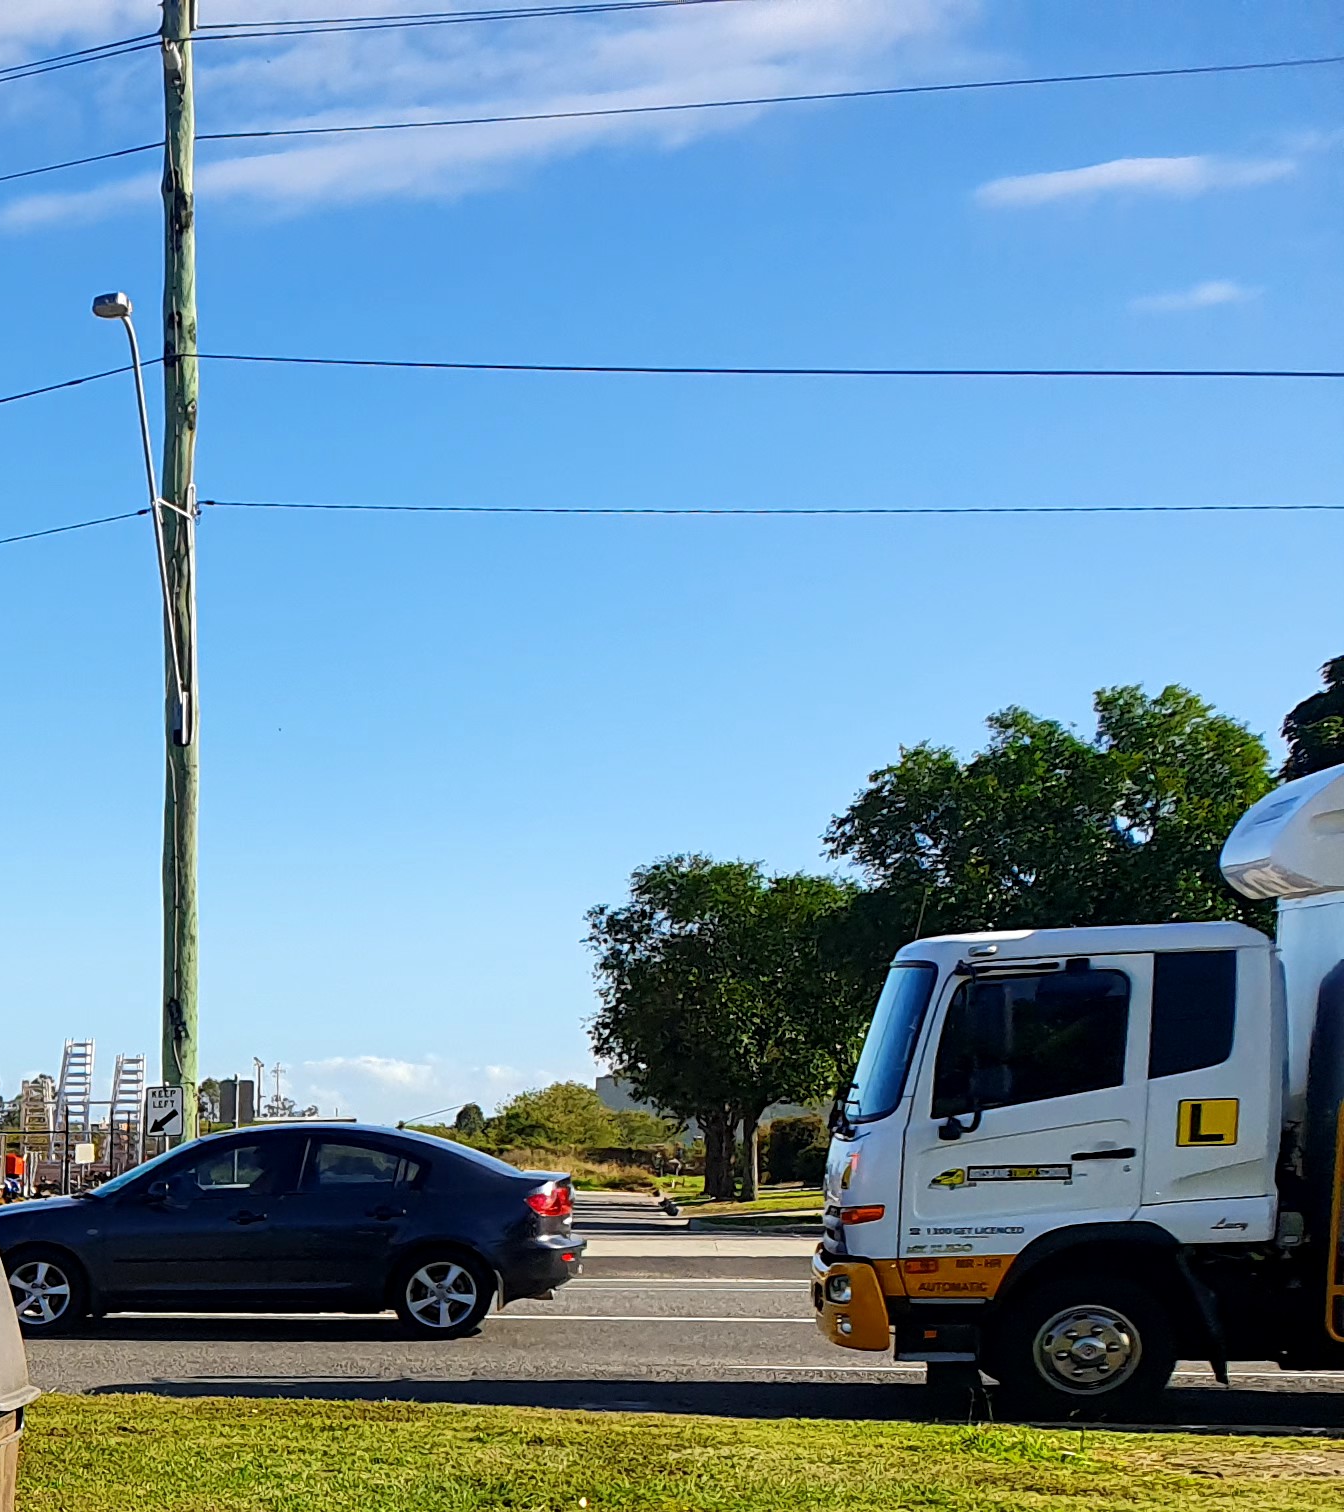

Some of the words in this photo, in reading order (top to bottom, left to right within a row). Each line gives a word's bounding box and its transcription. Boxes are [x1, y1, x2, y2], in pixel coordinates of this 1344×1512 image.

[151, 1089, 177, 1098] KEEP
[152, 1100, 175, 1109] LEFT
[1188, 1104, 1224, 1142] L
[974, 1226, 1025, 1235] LICENCED
[918, 1282, 989, 1292] AUTOMATIC
